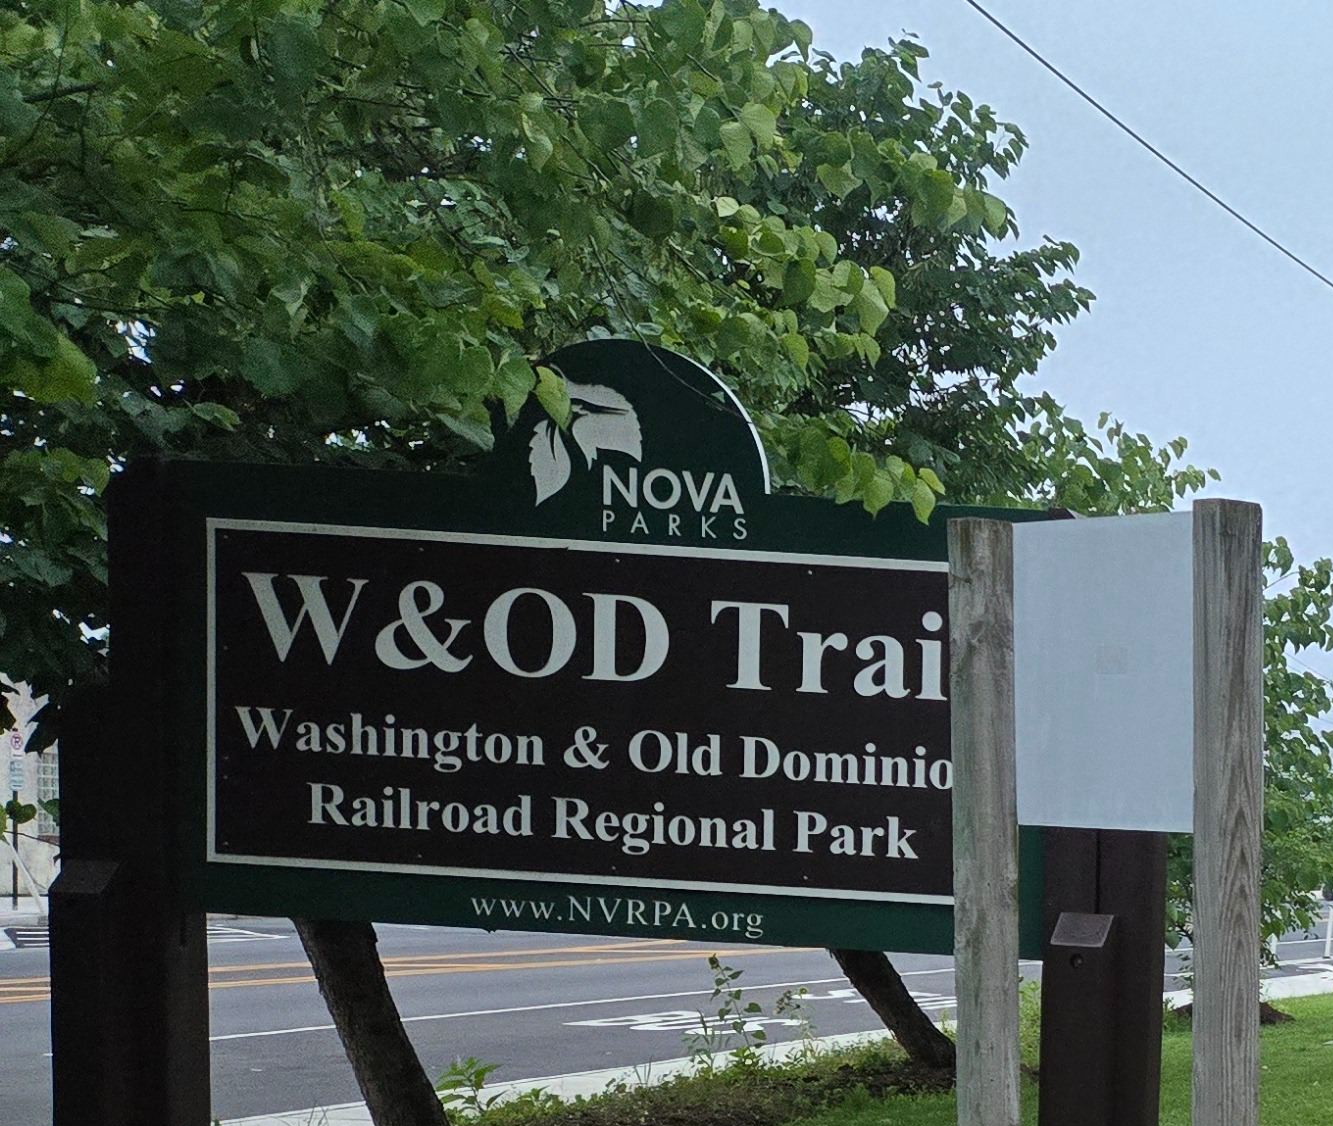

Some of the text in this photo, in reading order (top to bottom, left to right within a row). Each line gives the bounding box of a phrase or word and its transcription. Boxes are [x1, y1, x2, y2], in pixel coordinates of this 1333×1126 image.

[602, 464, 745, 515] NOVA
[601, 509, 749, 540] PARKS
[241, 572, 948, 701] W&OD Trai
[235, 706, 953, 790] Washington & Old Dominio
[306, 782, 918, 860] Railroad Regional Park
[470, 895, 764, 939] www.NVRPA.org
